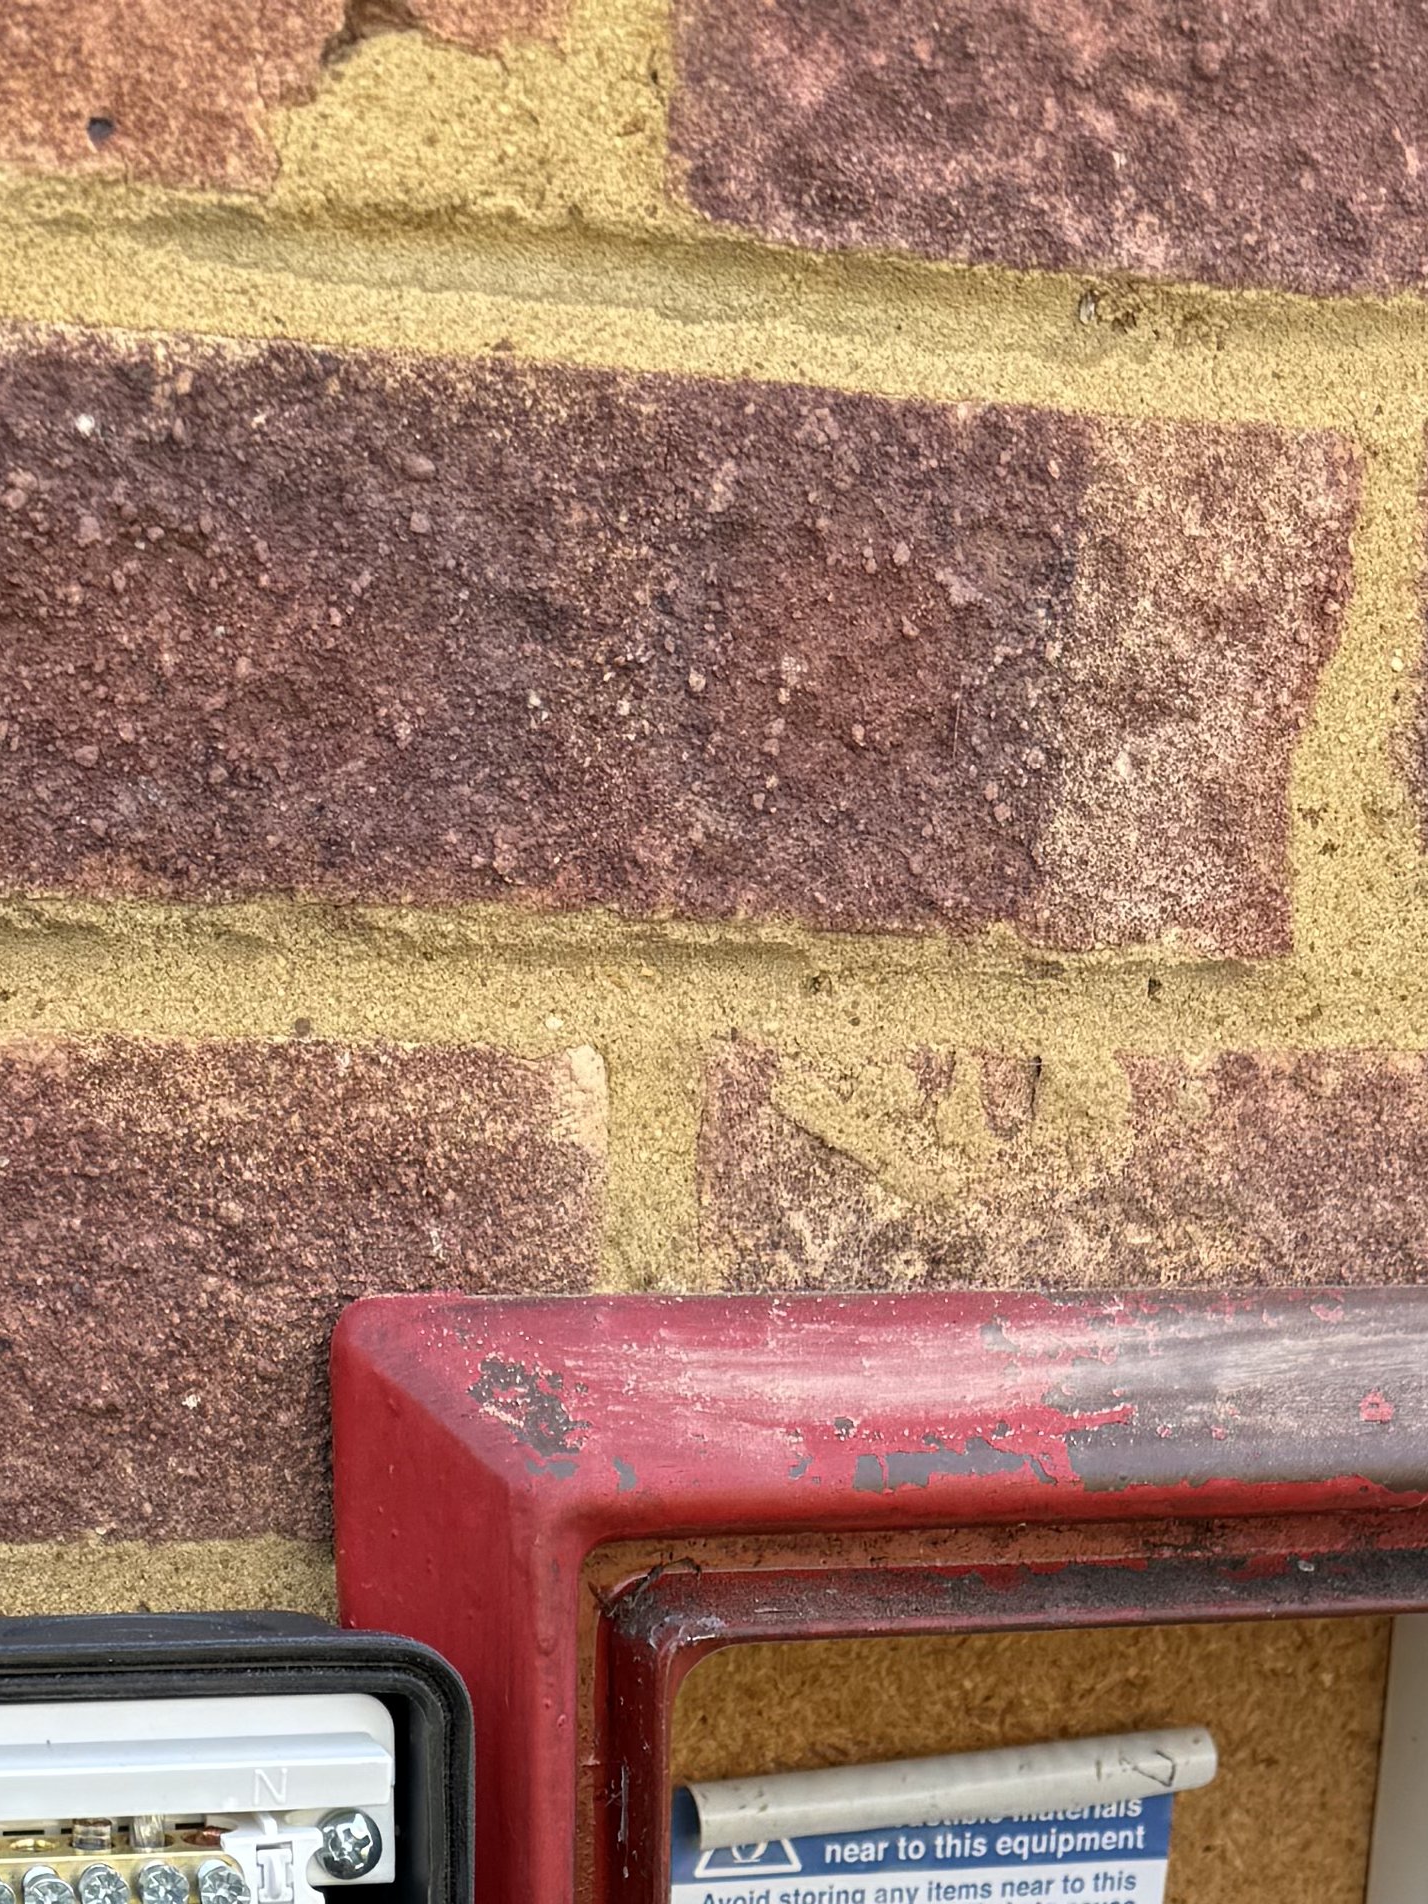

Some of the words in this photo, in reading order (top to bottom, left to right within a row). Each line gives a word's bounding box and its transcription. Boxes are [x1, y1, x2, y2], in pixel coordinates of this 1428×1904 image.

[254, 1767, 288, 1806] N
[824, 1841, 889, 1864] near
[897, 1837, 925, 1860] to
[934, 1832, 988, 1859] this
[996, 1825, 1146, 1861] equipment
[927, 1880, 992, 1902] items
[1001, 1878, 1054, 1899] near
[1062, 1875, 1085, 1895] to
[1093, 1870, 1137, 1893] this
